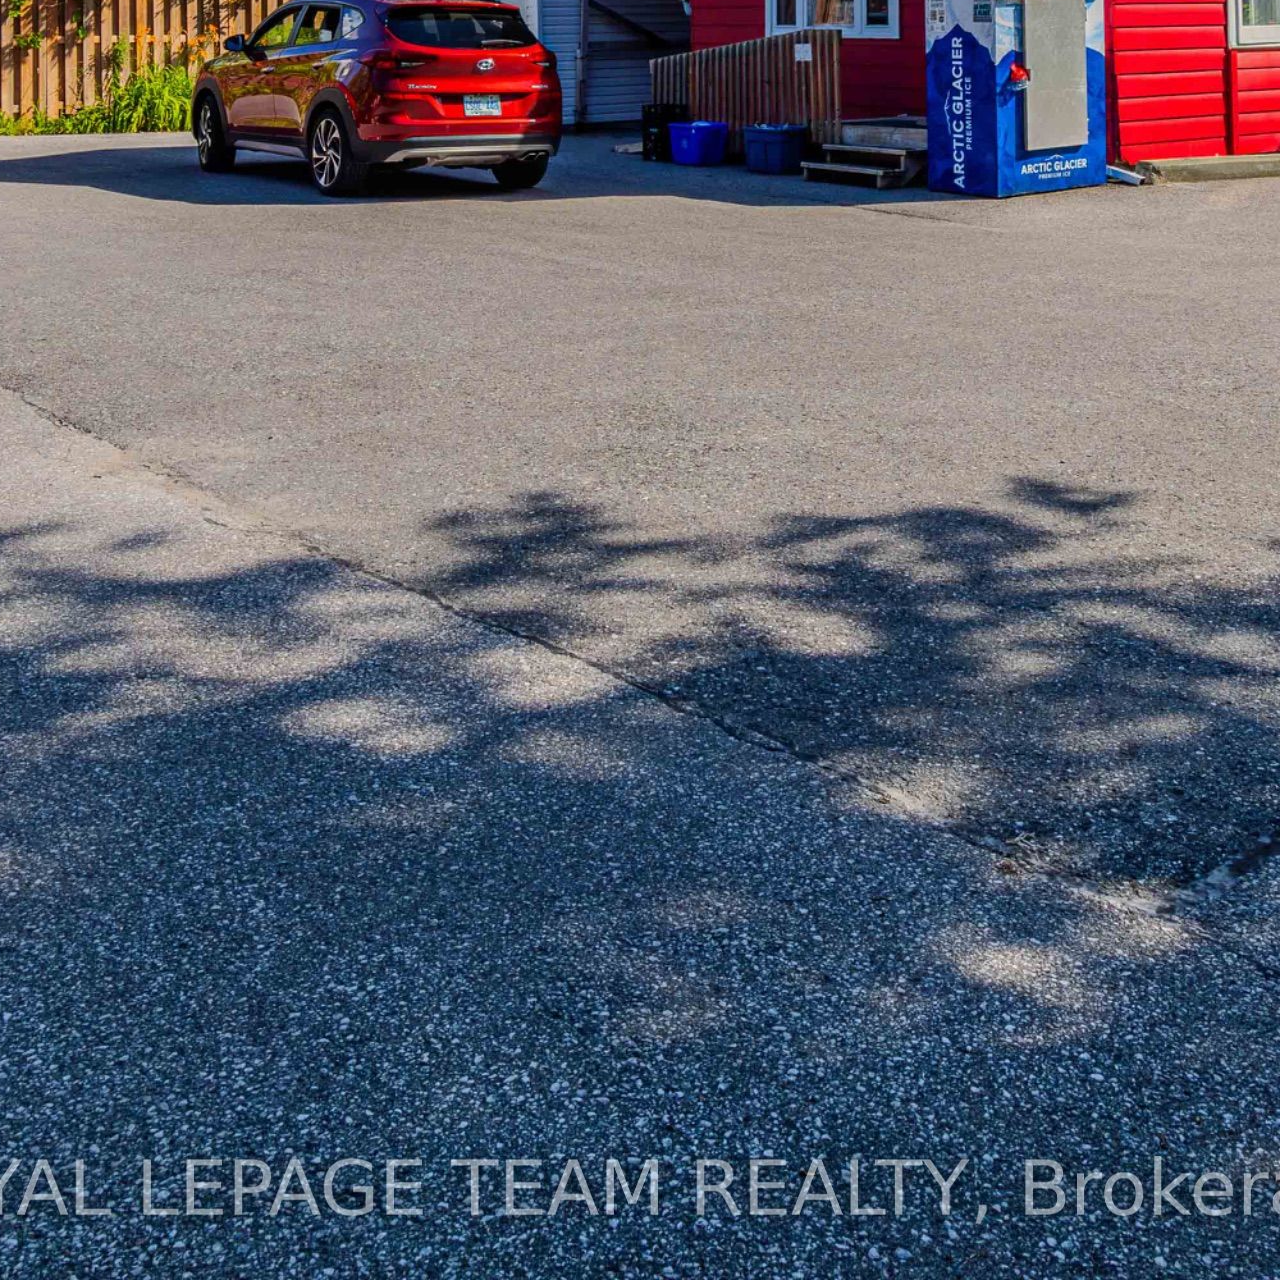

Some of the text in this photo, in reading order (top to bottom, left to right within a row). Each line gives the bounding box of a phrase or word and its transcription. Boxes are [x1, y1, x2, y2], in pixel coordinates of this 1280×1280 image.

[951, 36, 965, 189] ARCTIC GLACIER
[964, 76, 973, 151] PREMIUM ICE
[1021, 158, 1088, 175] ARCTIC GLACIER
